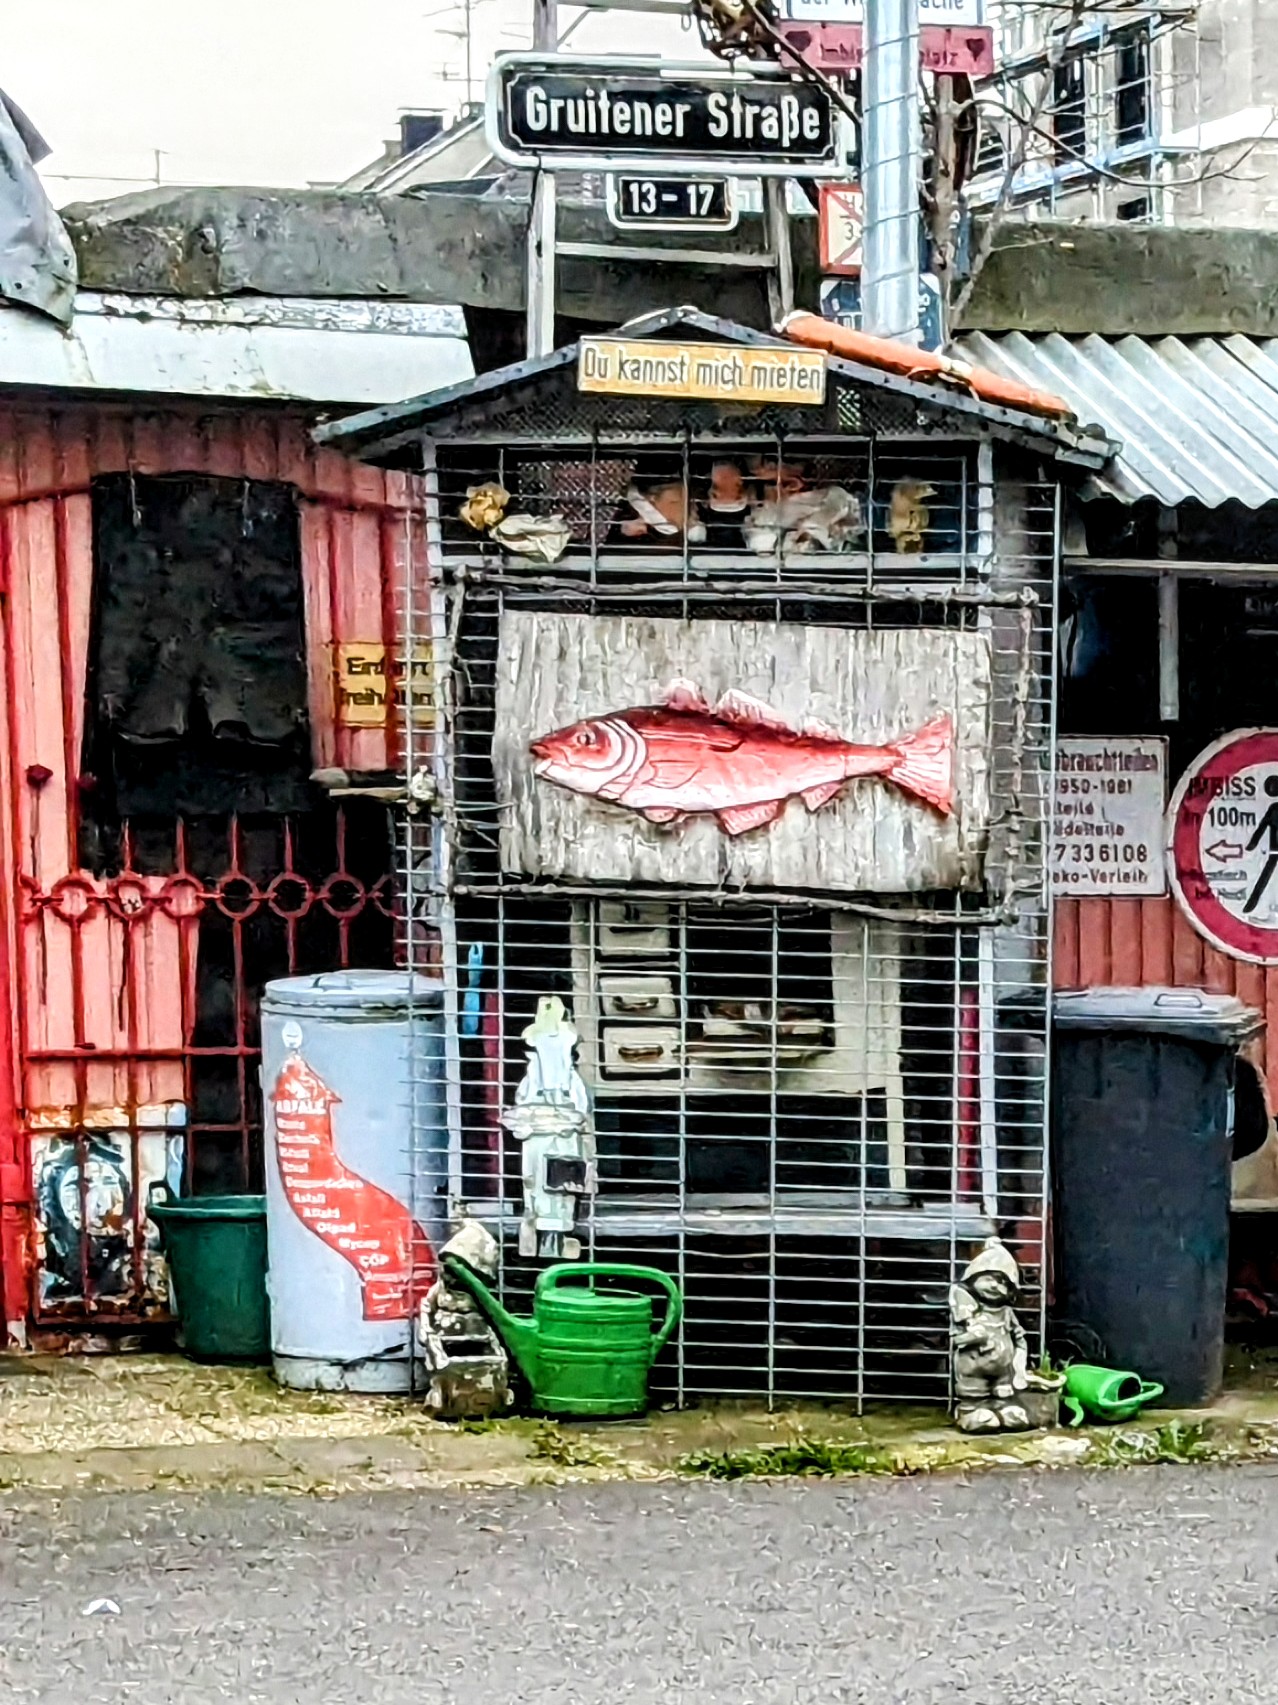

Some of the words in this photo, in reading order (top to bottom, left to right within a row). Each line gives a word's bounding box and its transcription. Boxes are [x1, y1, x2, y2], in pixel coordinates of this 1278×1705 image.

[525, 85, 692, 138] Gruitener
[707, 89, 821, 147] Straße
[584, 347, 609, 379] Du
[617, 349, 688, 384] kannst
[696, 352, 744, 388] mich
[751, 356, 821, 391] mieten
